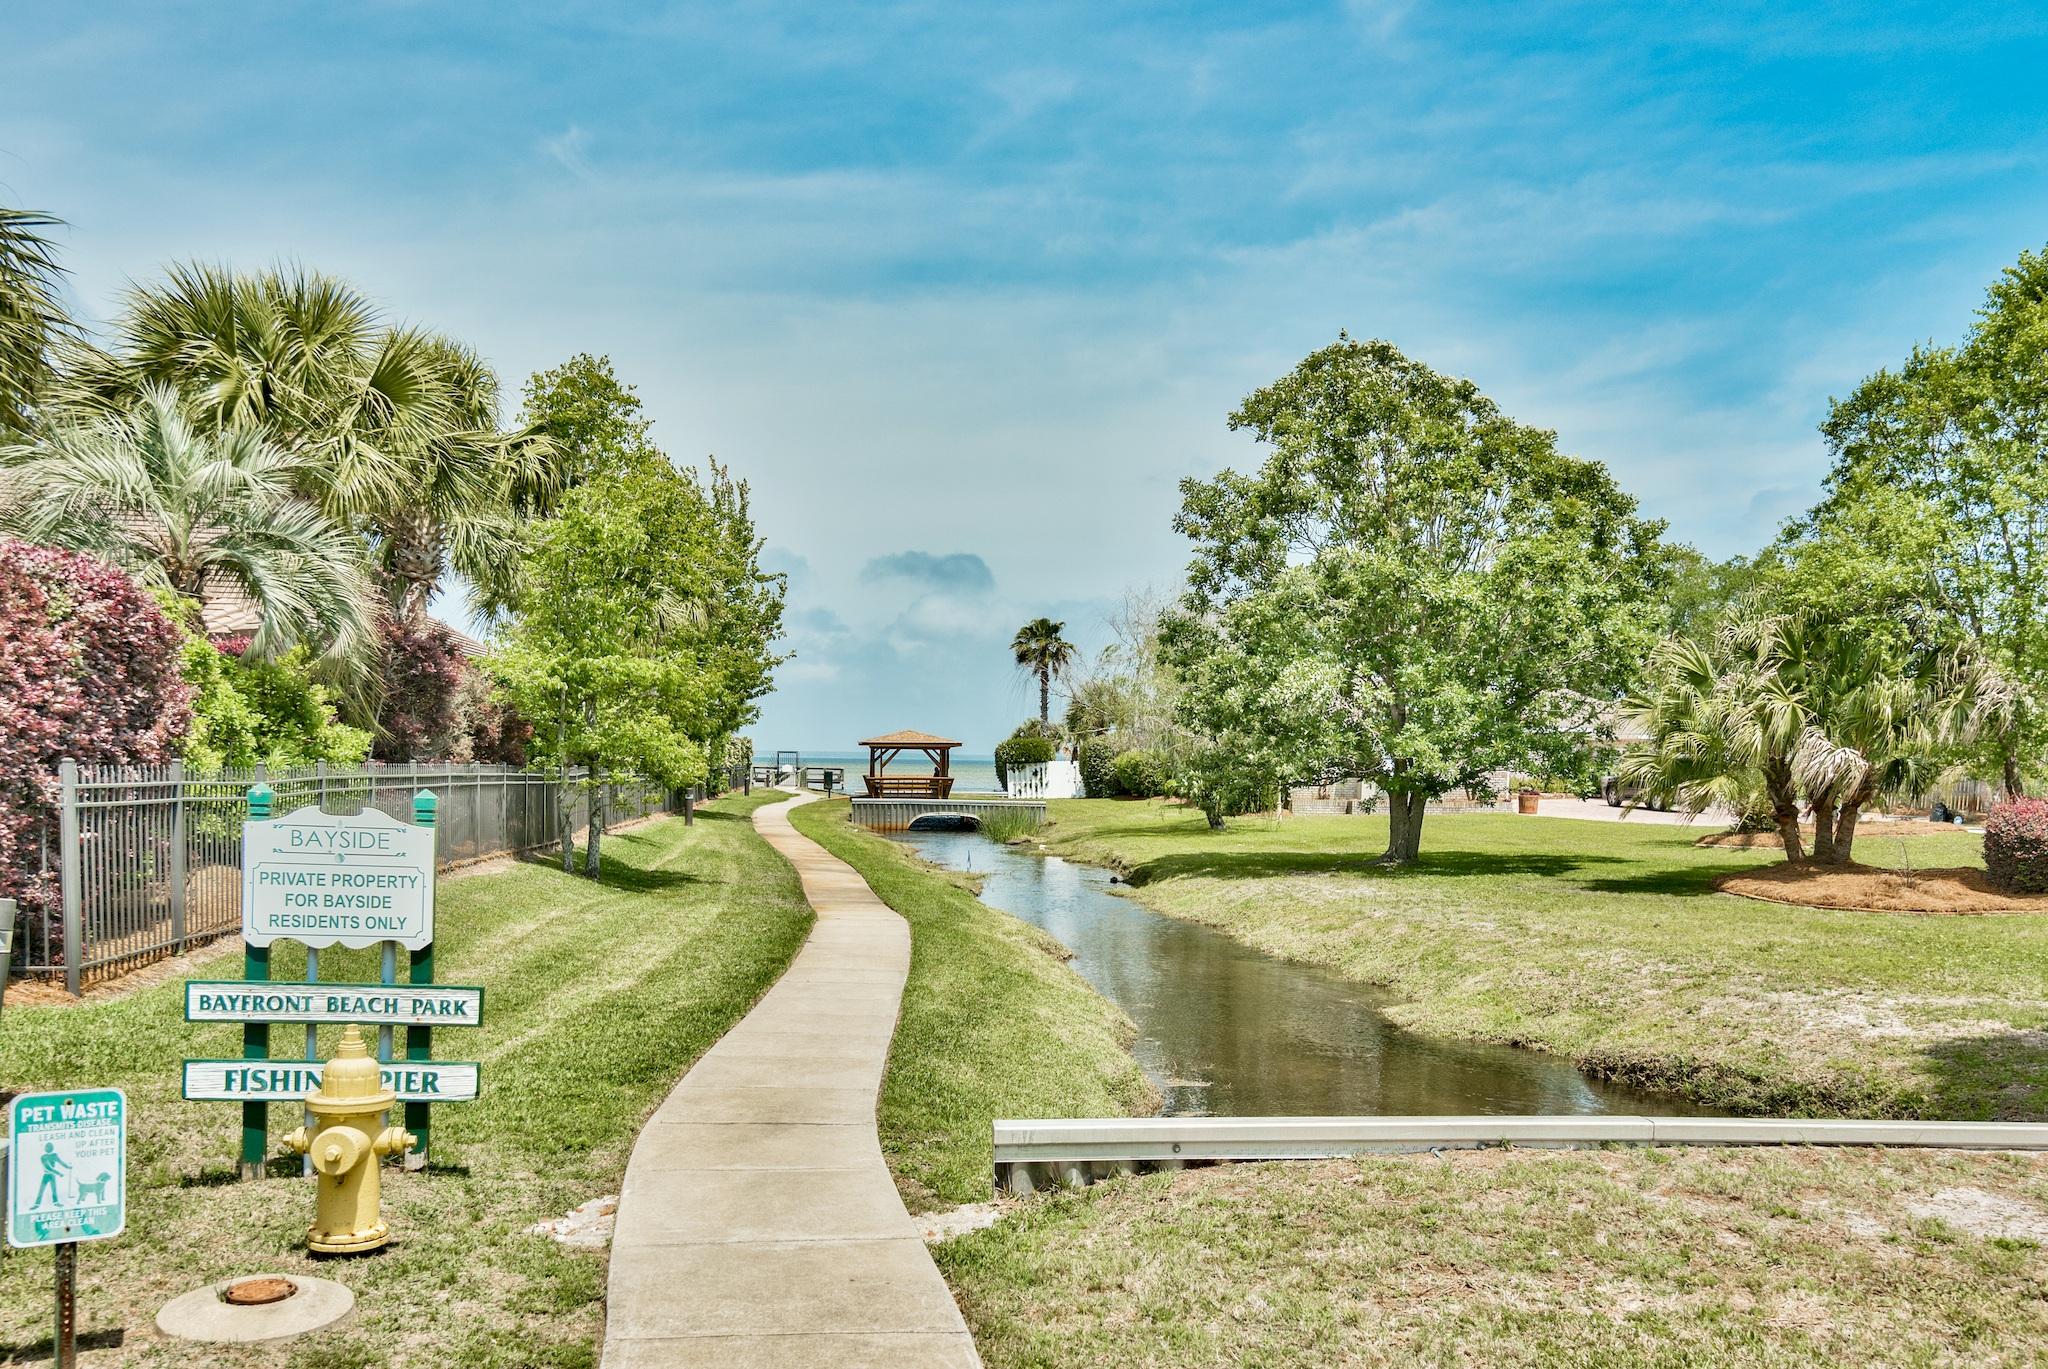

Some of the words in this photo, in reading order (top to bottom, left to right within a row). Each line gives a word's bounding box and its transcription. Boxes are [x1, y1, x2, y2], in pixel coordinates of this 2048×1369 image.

[291, 829, 390, 850] BAYSIDE
[259, 871, 326, 887] PRIVATE
[331, 873, 418, 889] PROPERTY
[285, 893, 318, 907] FOR
[323, 894, 392, 909] BAYSIDE
[269, 914, 360, 929] RESIDENTS
[365, 916, 407, 930] ONLY
[200, 994, 313, 1012] BAYFRONT
[327, 996, 399, 1014] BEACH
[412, 998, 469, 1016] PARK
[224, 1068, 324, 1092] FISHIN
[380, 1070, 440, 1093] PIER
[21, 1106, 55, 1123] PET
[60, 1101, 118, 1120] WASTE
[28, 1120, 75, 1132] TRANSMITS
[39, 1132, 66, 1142] LEASH
[69, 1130, 86, 1139] AND
[89, 1128, 115, 1137] CLEAN
[75, 1140, 87, 1149] UP
[90, 1138, 115, 1147] AFTER
[75, 1149, 98, 1158] YOUR
[100, 1147, 115, 1157] PET
